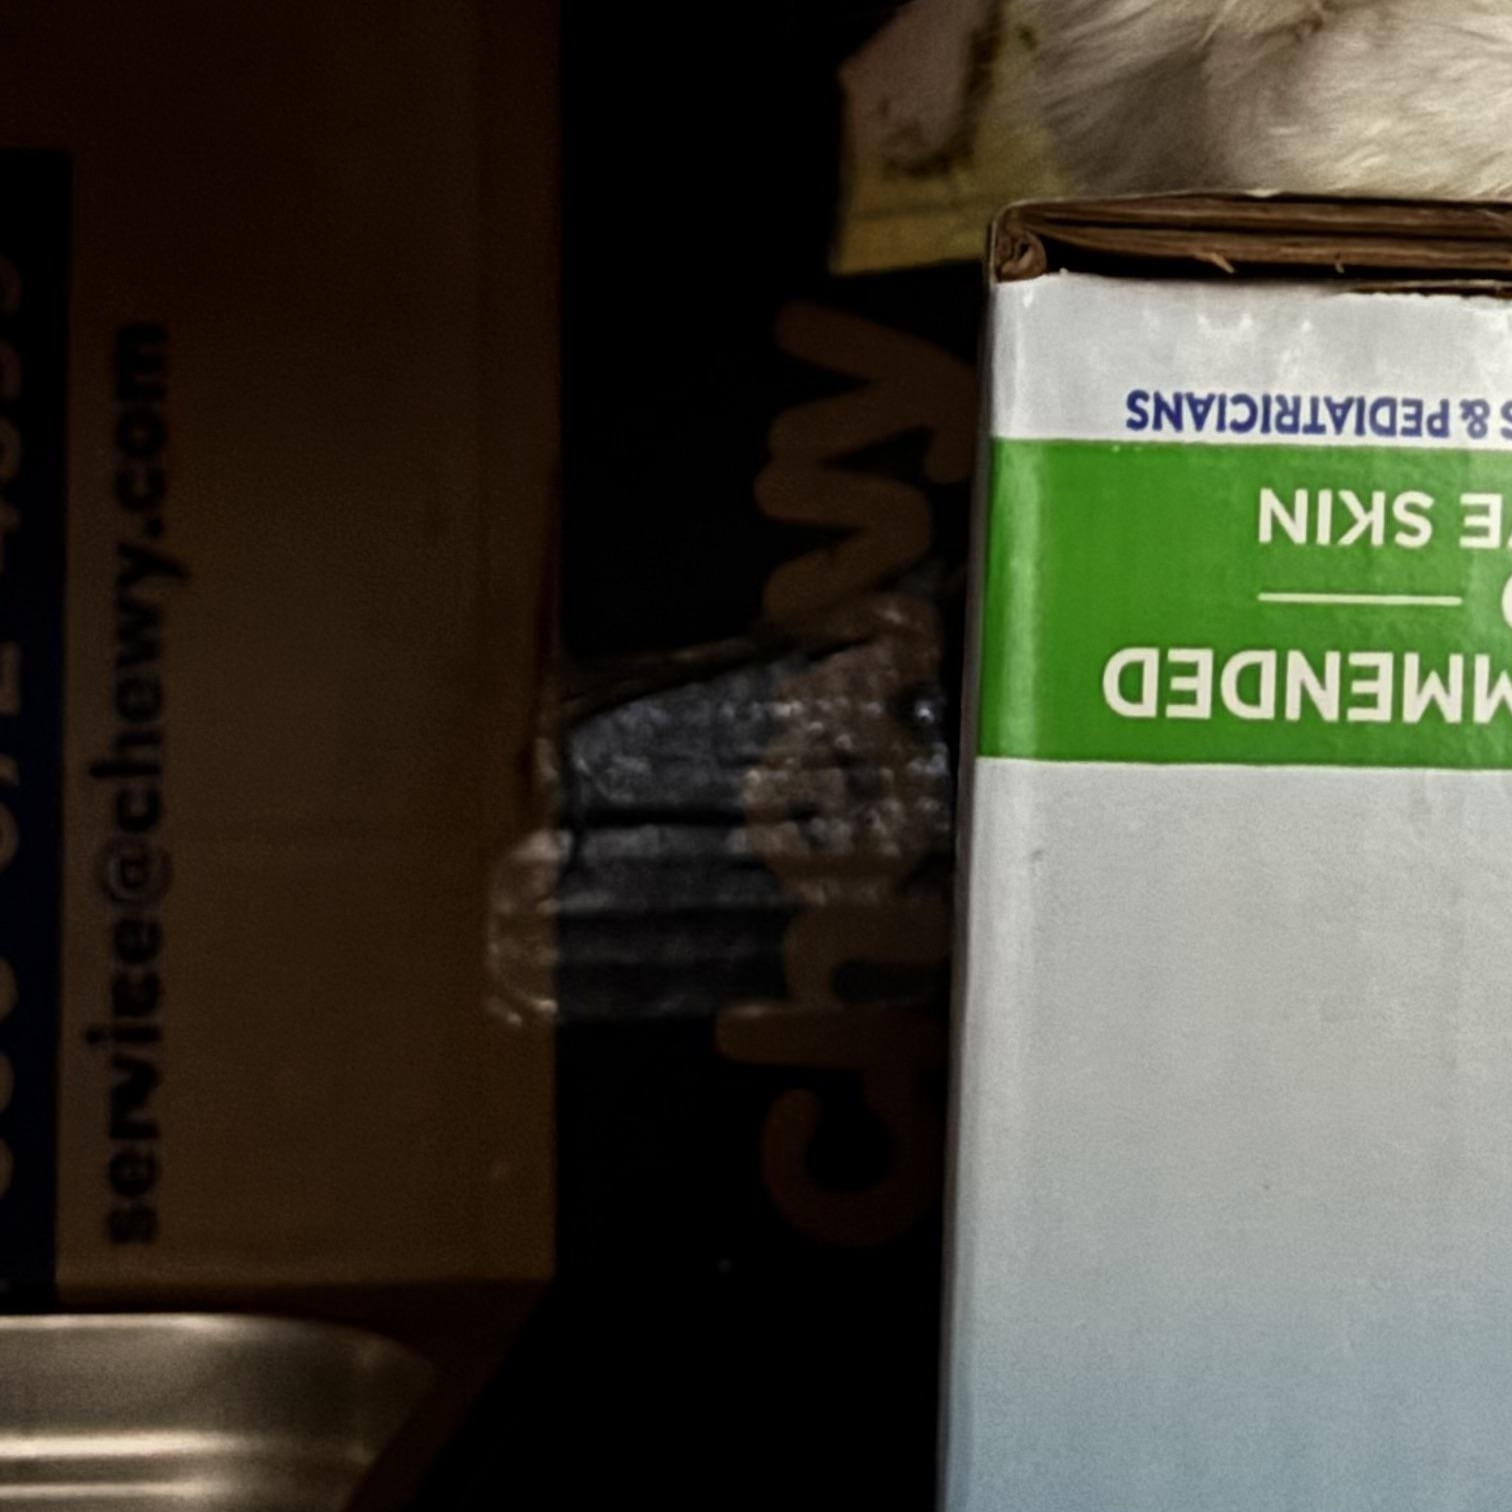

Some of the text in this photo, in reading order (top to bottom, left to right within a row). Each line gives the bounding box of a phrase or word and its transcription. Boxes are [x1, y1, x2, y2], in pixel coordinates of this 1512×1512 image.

[1125, 388, 1450, 439] PEDIATRICIANS
[1459, 398, 1491, 440] &
[1257, 487, 1436, 549] SKIN
[91, 320, 190, 1246] service@chewy.com
